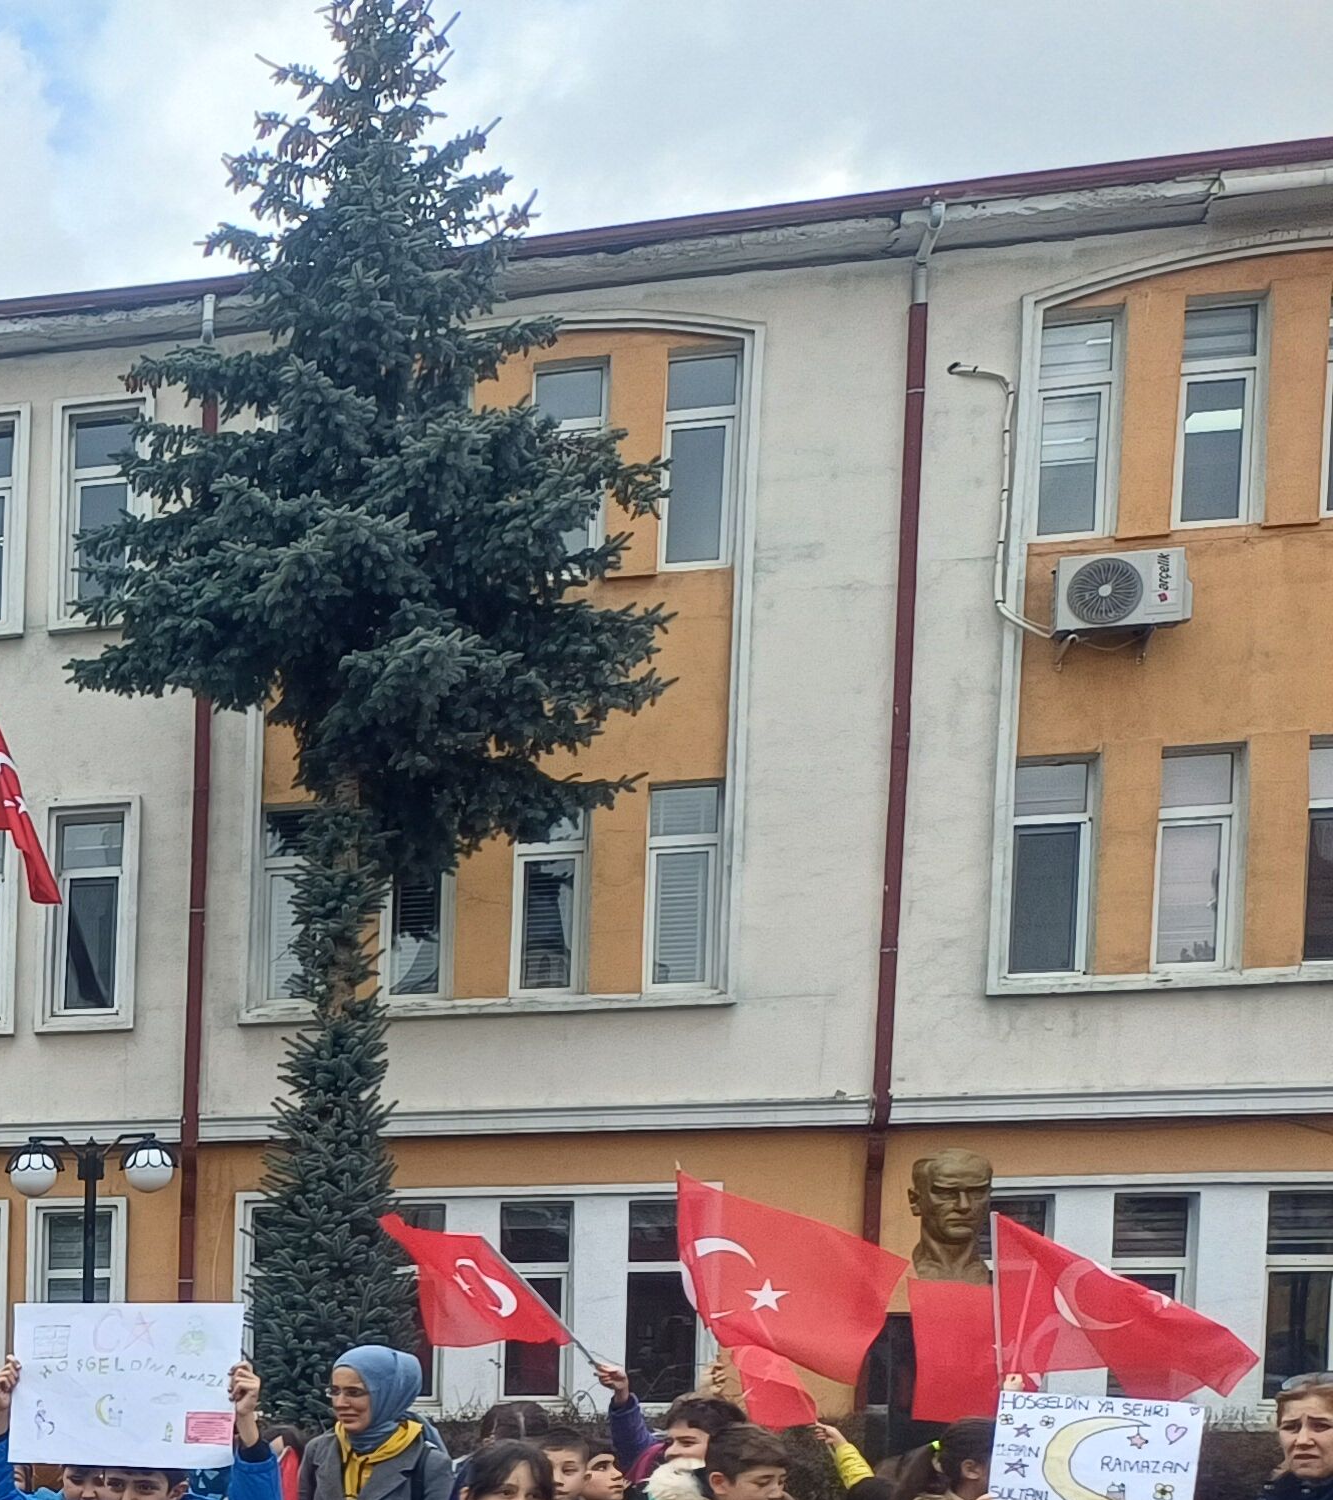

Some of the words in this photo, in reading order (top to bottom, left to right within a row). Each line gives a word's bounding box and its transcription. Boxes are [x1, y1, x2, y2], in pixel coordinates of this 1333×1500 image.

[1156, 552, 1172, 591] arçelik
[1098, 1400, 1114, 1414] YA
[1101, 1455, 1190, 1474] RAMAZAN
